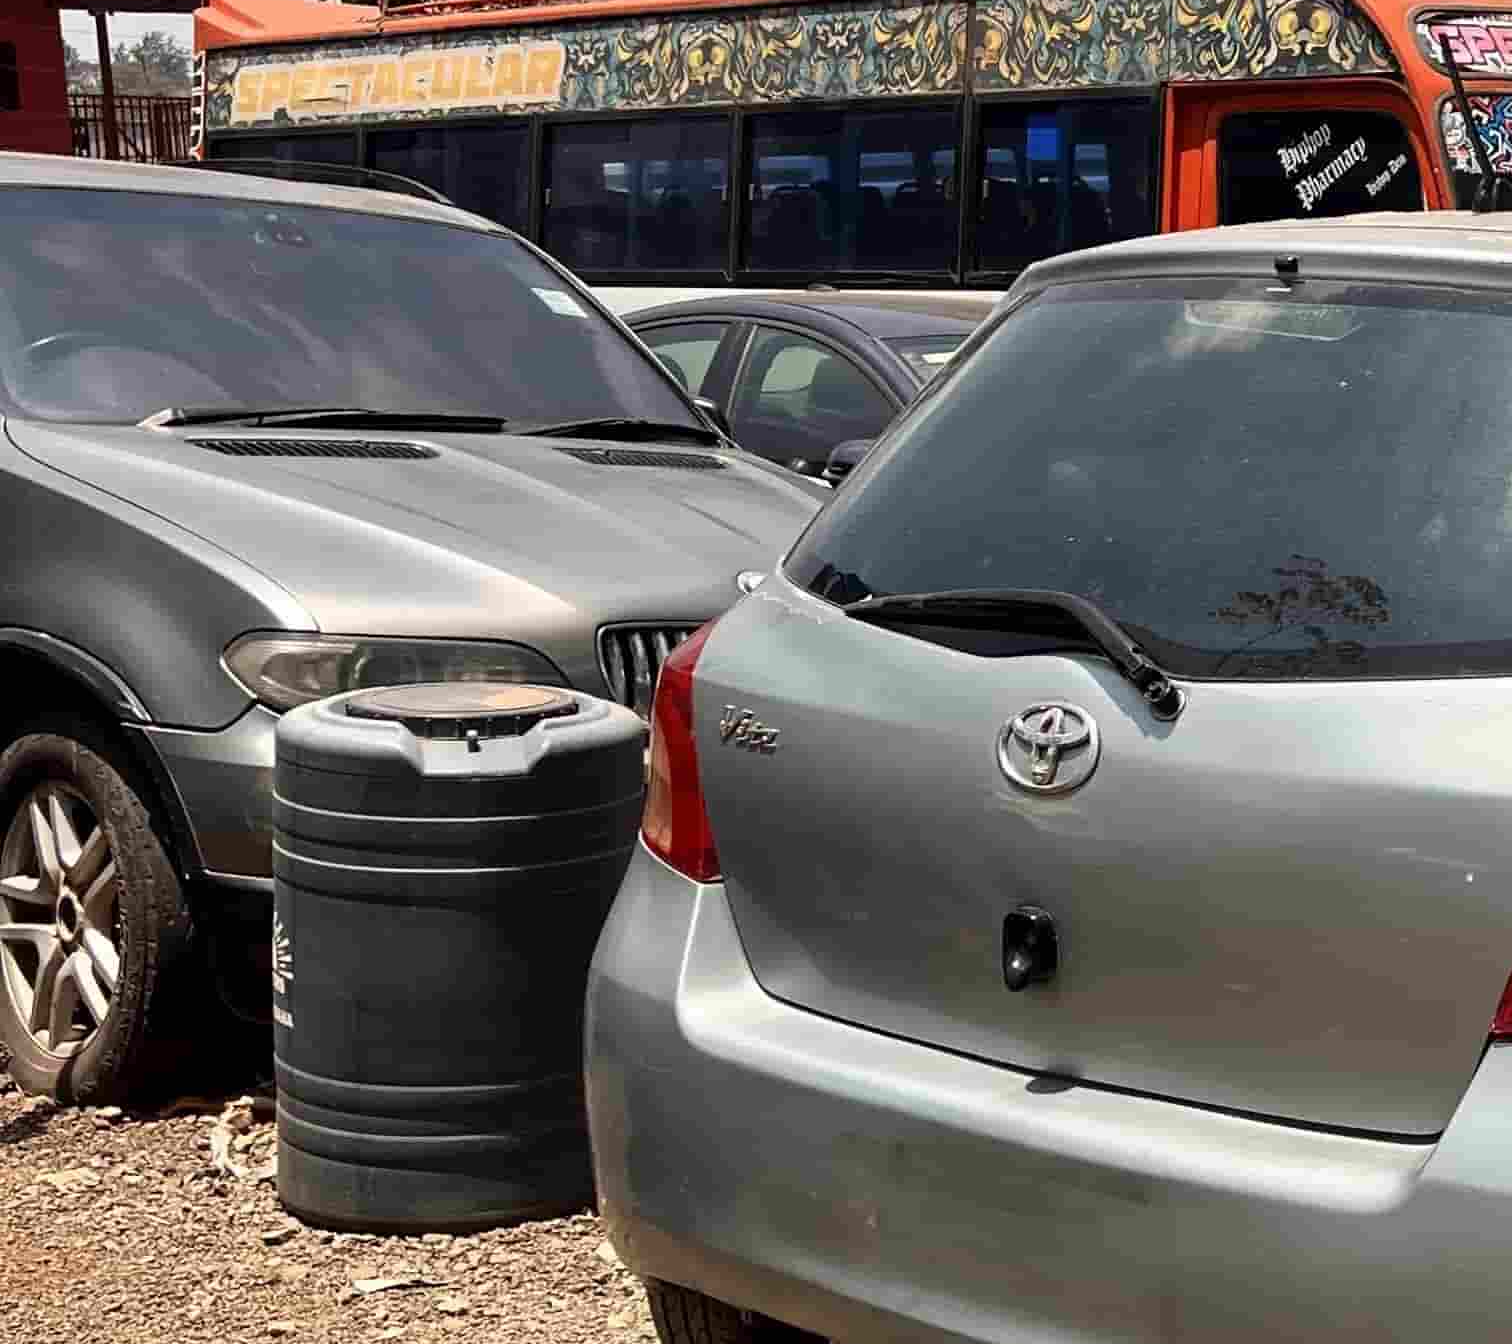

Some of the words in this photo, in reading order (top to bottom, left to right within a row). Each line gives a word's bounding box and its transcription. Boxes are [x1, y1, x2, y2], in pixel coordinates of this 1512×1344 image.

[235, 45, 563, 120] SPECTACULAR
[1294, 135, 1369, 211] Pharmacy
[719, 704, 782, 752] Vitz
